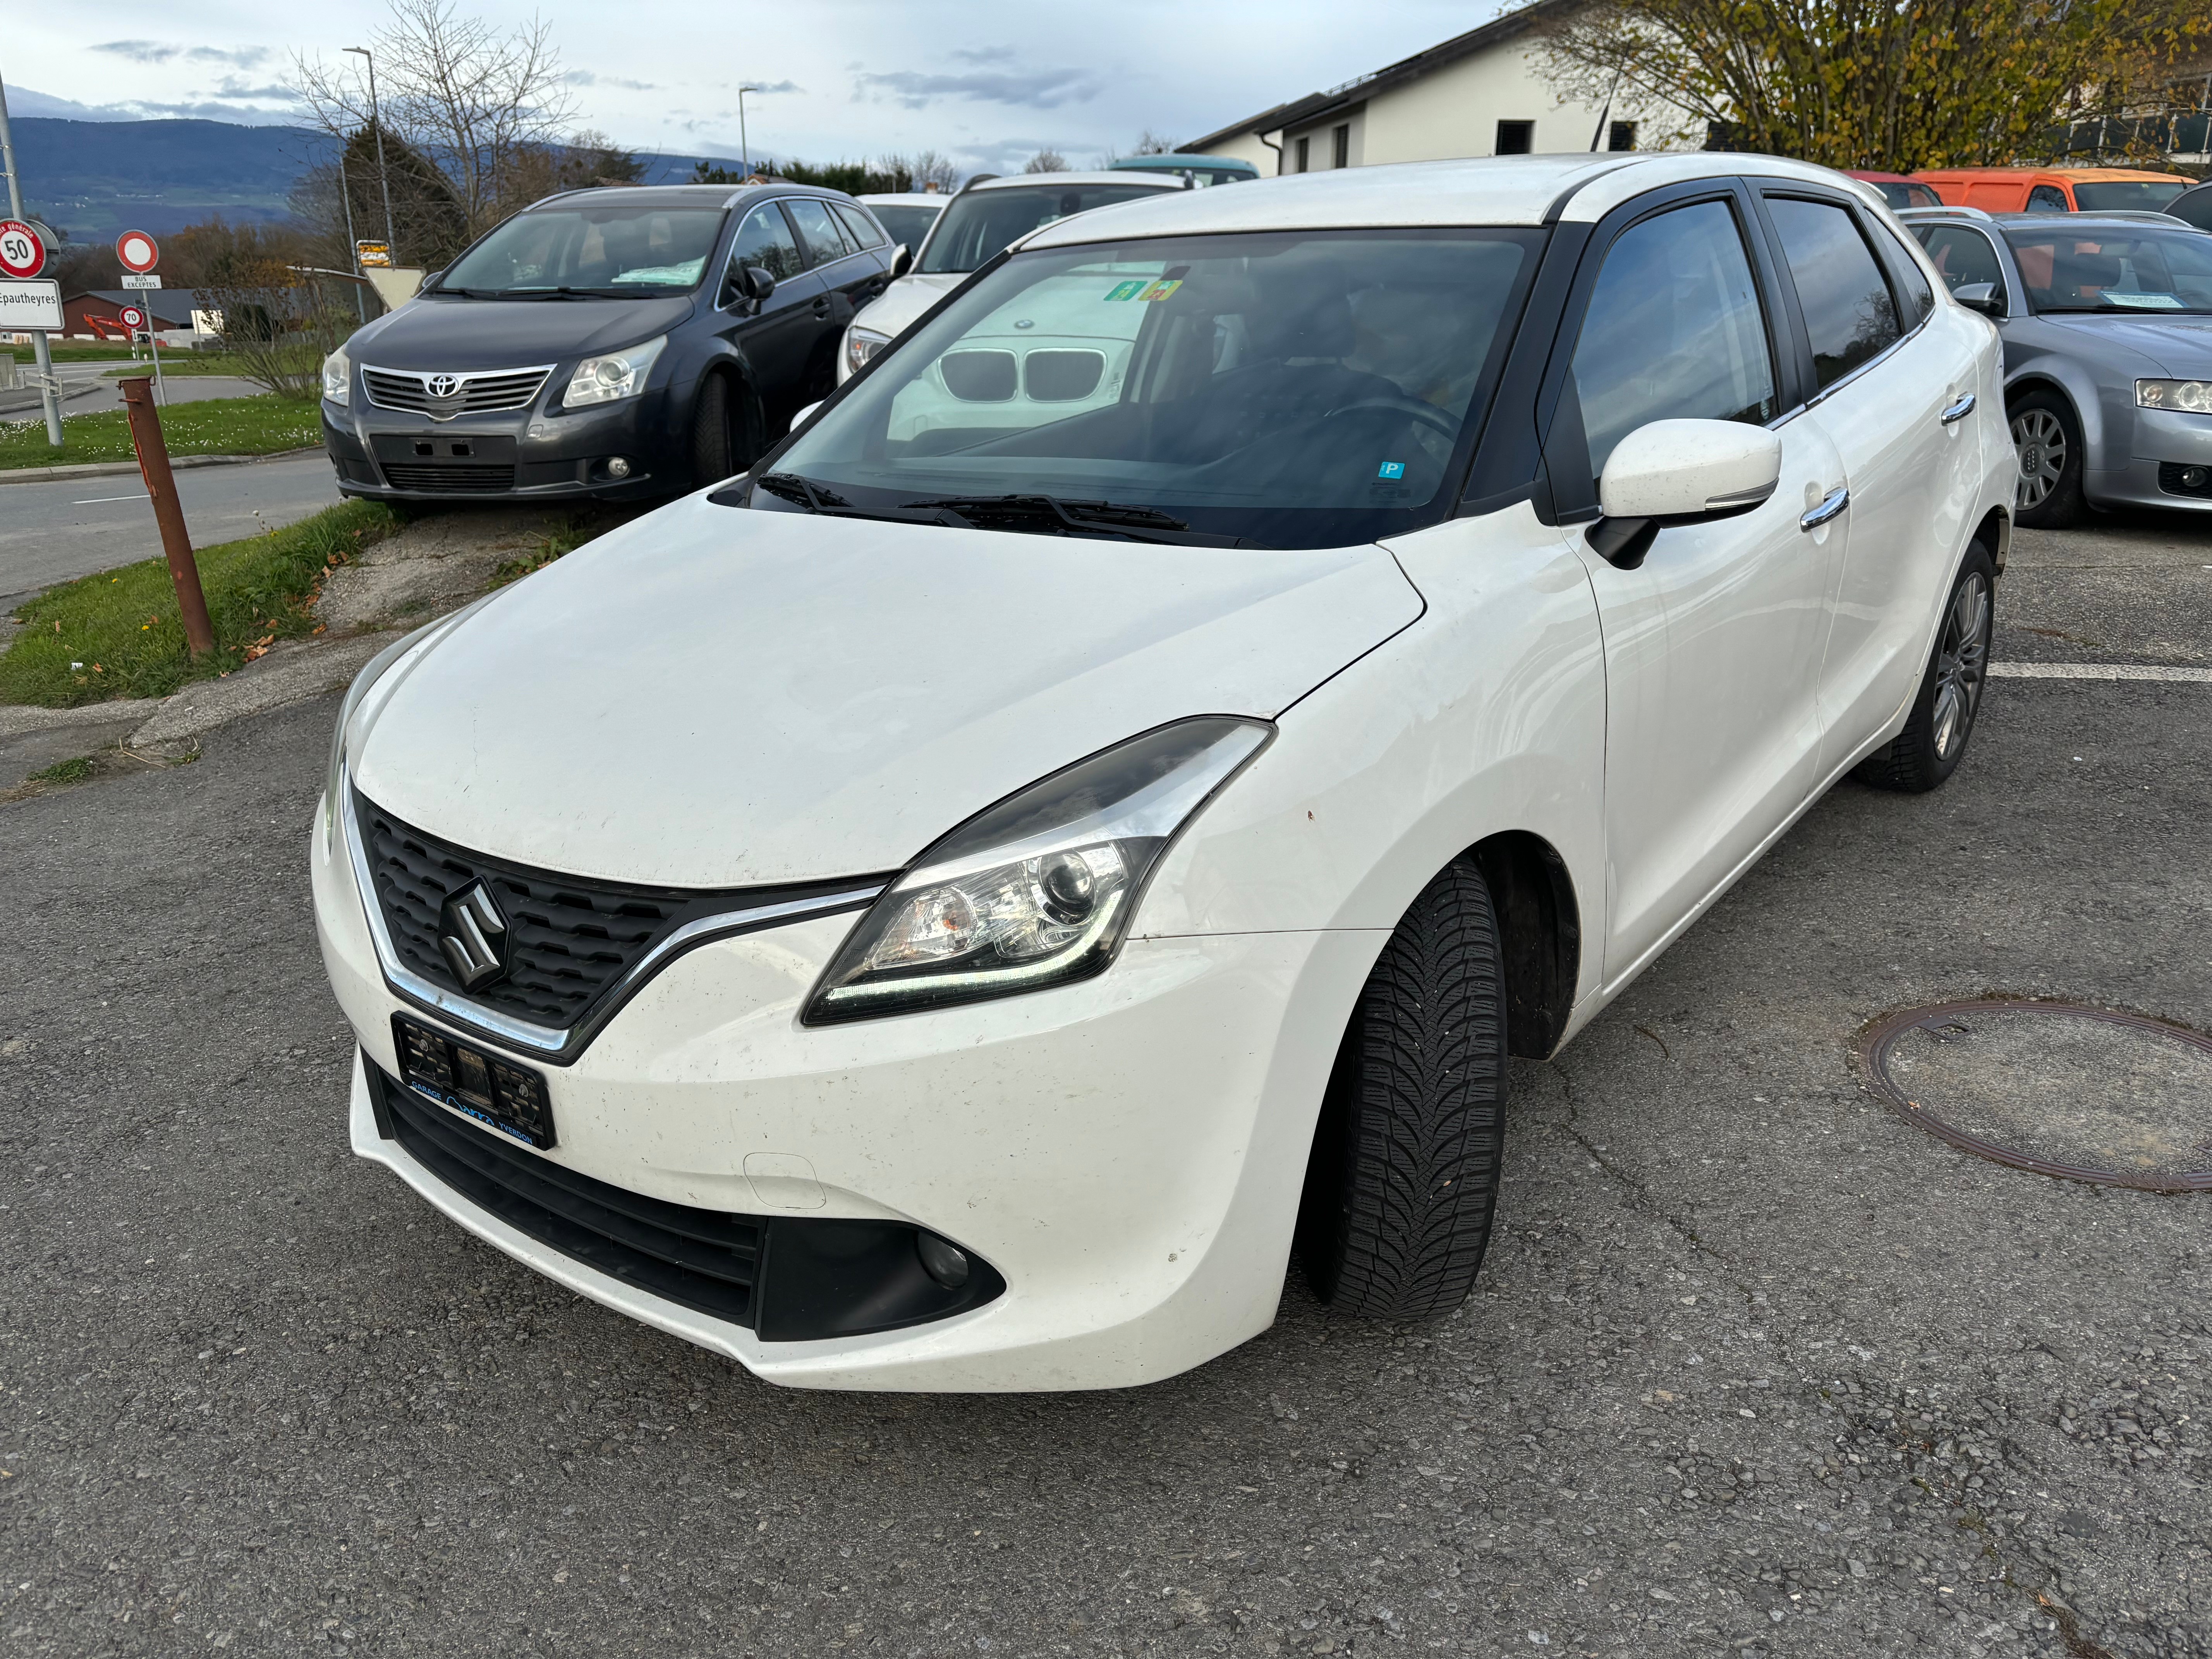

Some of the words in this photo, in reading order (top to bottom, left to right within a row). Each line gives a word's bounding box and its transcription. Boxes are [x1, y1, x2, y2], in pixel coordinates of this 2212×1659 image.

[5, 239, 28, 260] 50
[126, 313, 136, 321] 70
[1386, 463, 1398, 474] P
[412, 1081, 442, 1100] GARAGE
[498, 1121, 532, 1145] YVERDON
